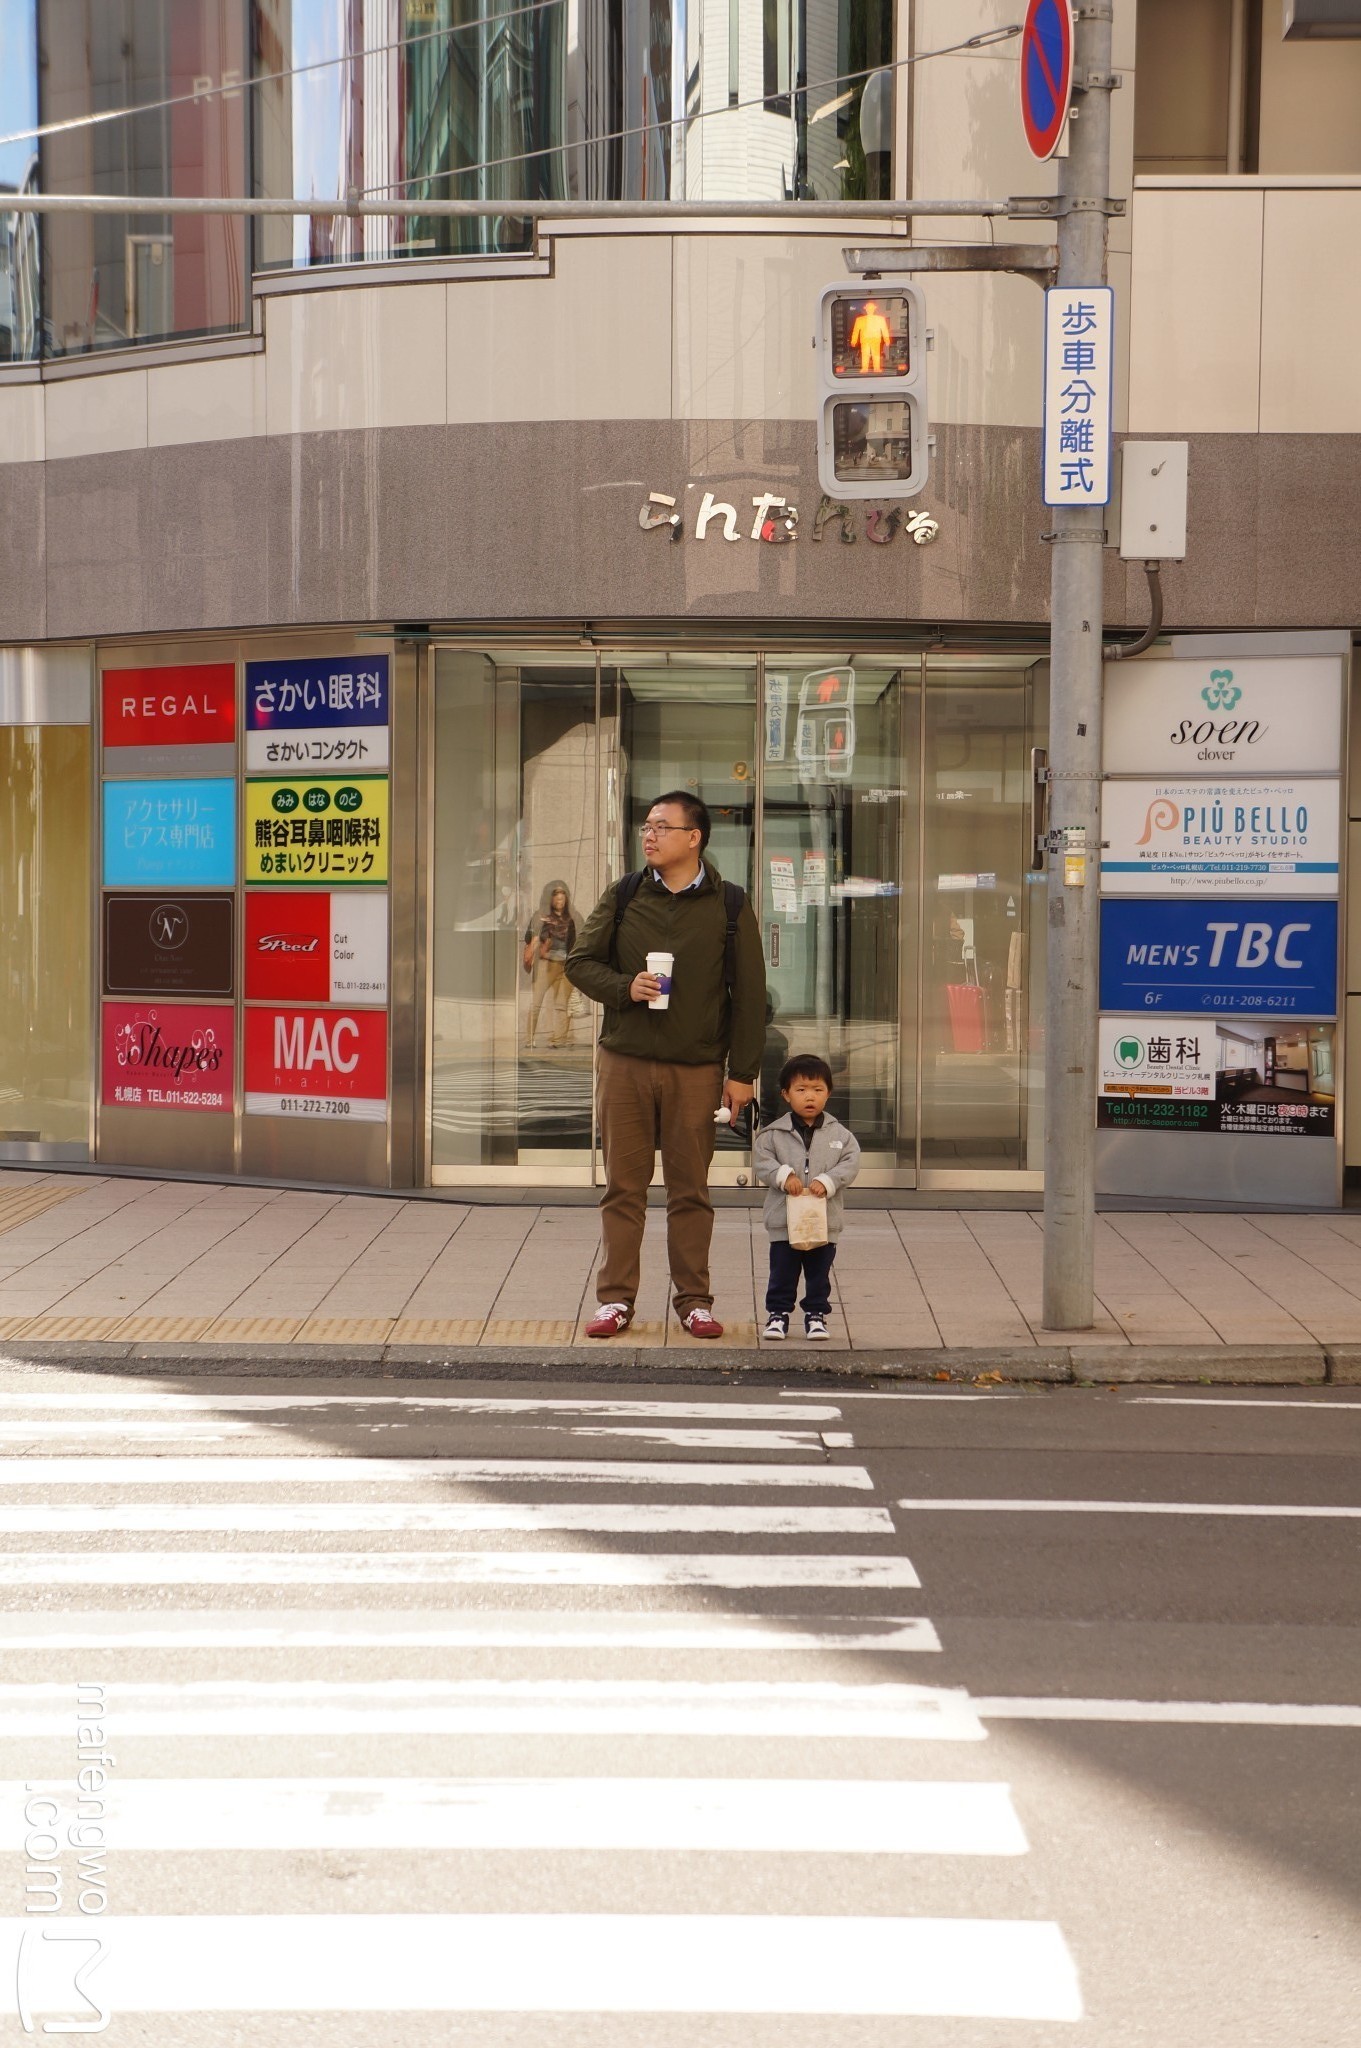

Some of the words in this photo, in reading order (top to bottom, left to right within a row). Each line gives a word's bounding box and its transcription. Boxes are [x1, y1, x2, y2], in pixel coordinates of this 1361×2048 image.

[1060, 301, 1097, 493] 歩車分離式
[255, 672, 381, 712] さかい眼科
[122, 695, 217, 717] REGAL
[1170, 720, 1269, 745] soen
[266, 740, 368, 761] さかいコンタクト
[1197, 748, 1235, 761] clover
[124, 797, 216, 822] アクセサリー
[277, 792, 294, 807] みみ
[308, 791, 326, 807] はな
[339, 791, 357, 806] のど
[1235, 806, 1308, 833] BELLO
[123, 823, 215, 849] ピアス専門店
[255, 817, 381, 848] 熊谷耳鼻咽喉科
[1183, 836, 1242, 845] BEAUTY
[1251, 836, 1308, 845] STUDIO
[260, 851, 375, 874] めまいクリニック
[1170, 876, 1268, 887] http://www.piubello.co.jp/
[334, 934, 348, 944] Cut
[1126, 944, 1200, 966] MEN'S
[1206, 922, 1312, 969] TBC
[334, 950, 354, 960] Color
[1144, 991, 1163, 1005] 6F
[1213, 995, 1296, 1007] 011-208-6211
[127, 1024, 222, 1077] Shapes
[274, 1016, 360, 1074] MAC
[1147, 1036, 1201, 1064] 歯科
[115, 1087, 142, 1102] 札幌店
[147, 1088, 223, 1106] TEL.011-522-5284
[1174, 1087, 1209, 1096] 当ビル3階
[280, 1098, 350, 1114] 011-272-7200
[1106, 1102, 1208, 1117] Tel.011-232-1182
